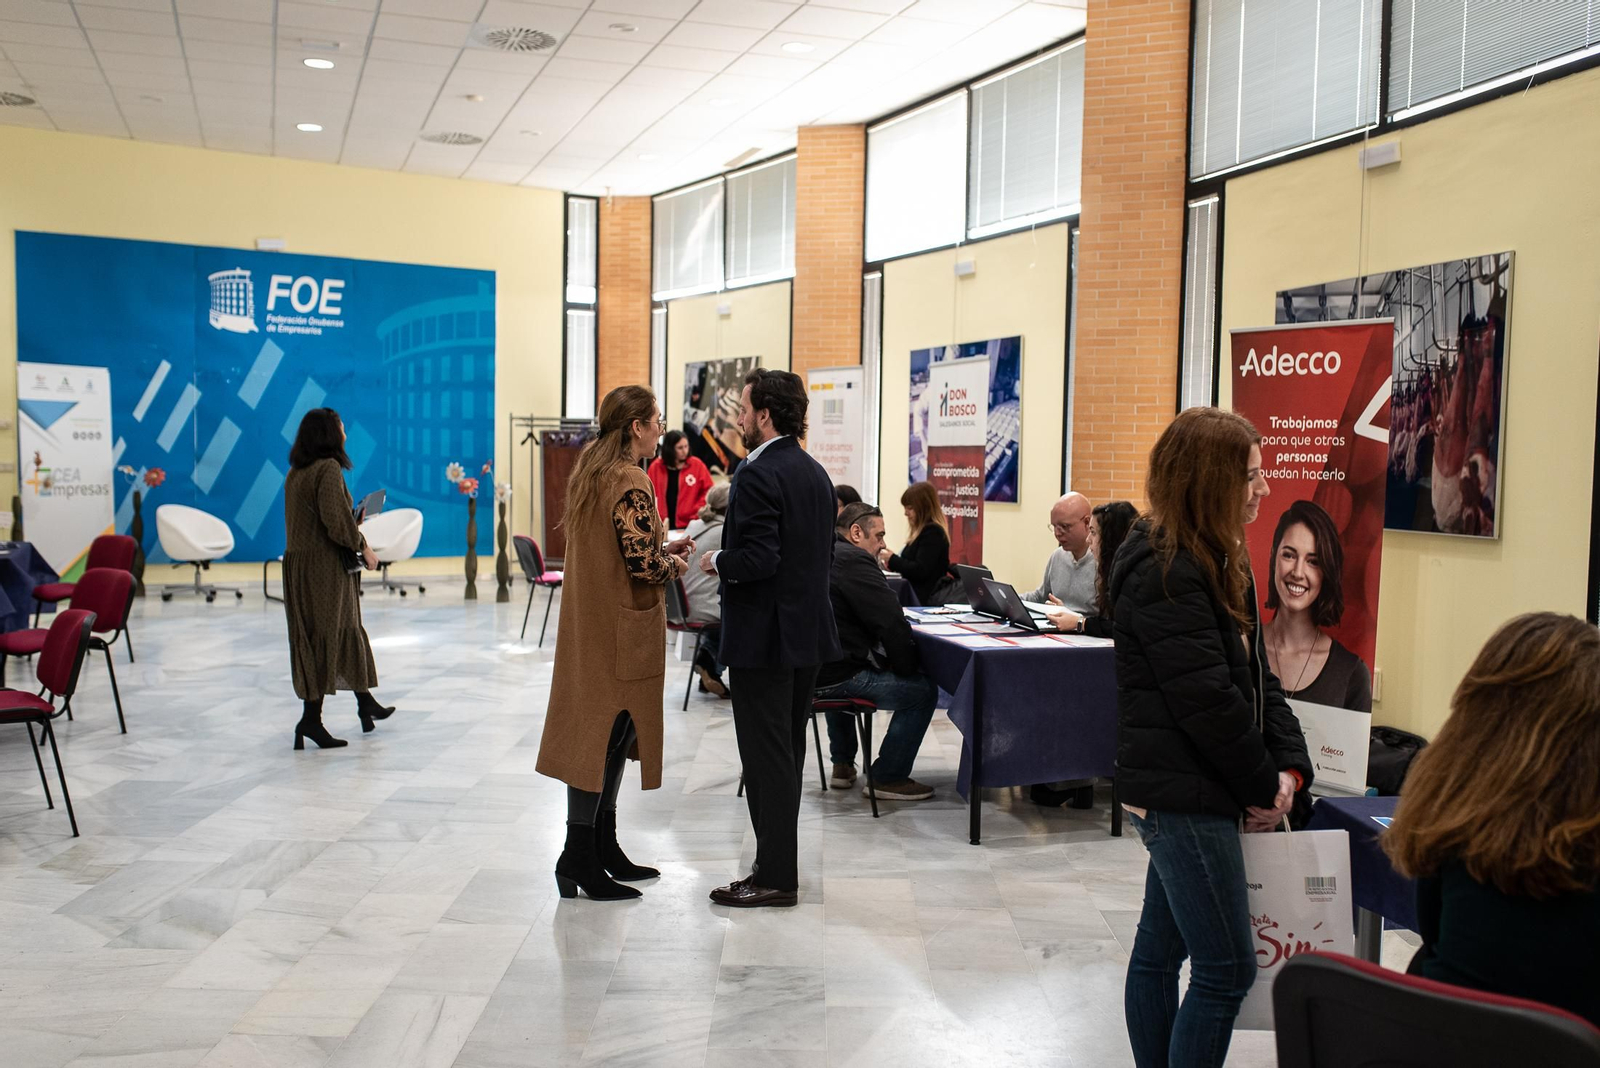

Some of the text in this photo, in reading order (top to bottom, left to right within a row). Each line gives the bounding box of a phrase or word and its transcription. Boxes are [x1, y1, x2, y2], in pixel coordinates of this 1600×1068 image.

[266, 274, 345, 315] FOE
[266, 313, 307, 325] Federación
[266, 323, 322, 335] de Empresarios
[1239, 345, 1341, 377] Adecco
[949, 388, 967, 401] DON
[949, 403, 977, 416] BOSCO
[1269, 415, 1338, 432] Trabajamos
[1261, 435, 1345, 449] para que otras
[1276, 452, 1328, 465] personas
[53, 468, 81, 482] CEA
[933, 466, 979, 479] comprometida
[1302, 467, 1345, 481] hacerlo
[955, 483, 979, 497] justicia
[1321, 745, 1344, 757] Adecco
